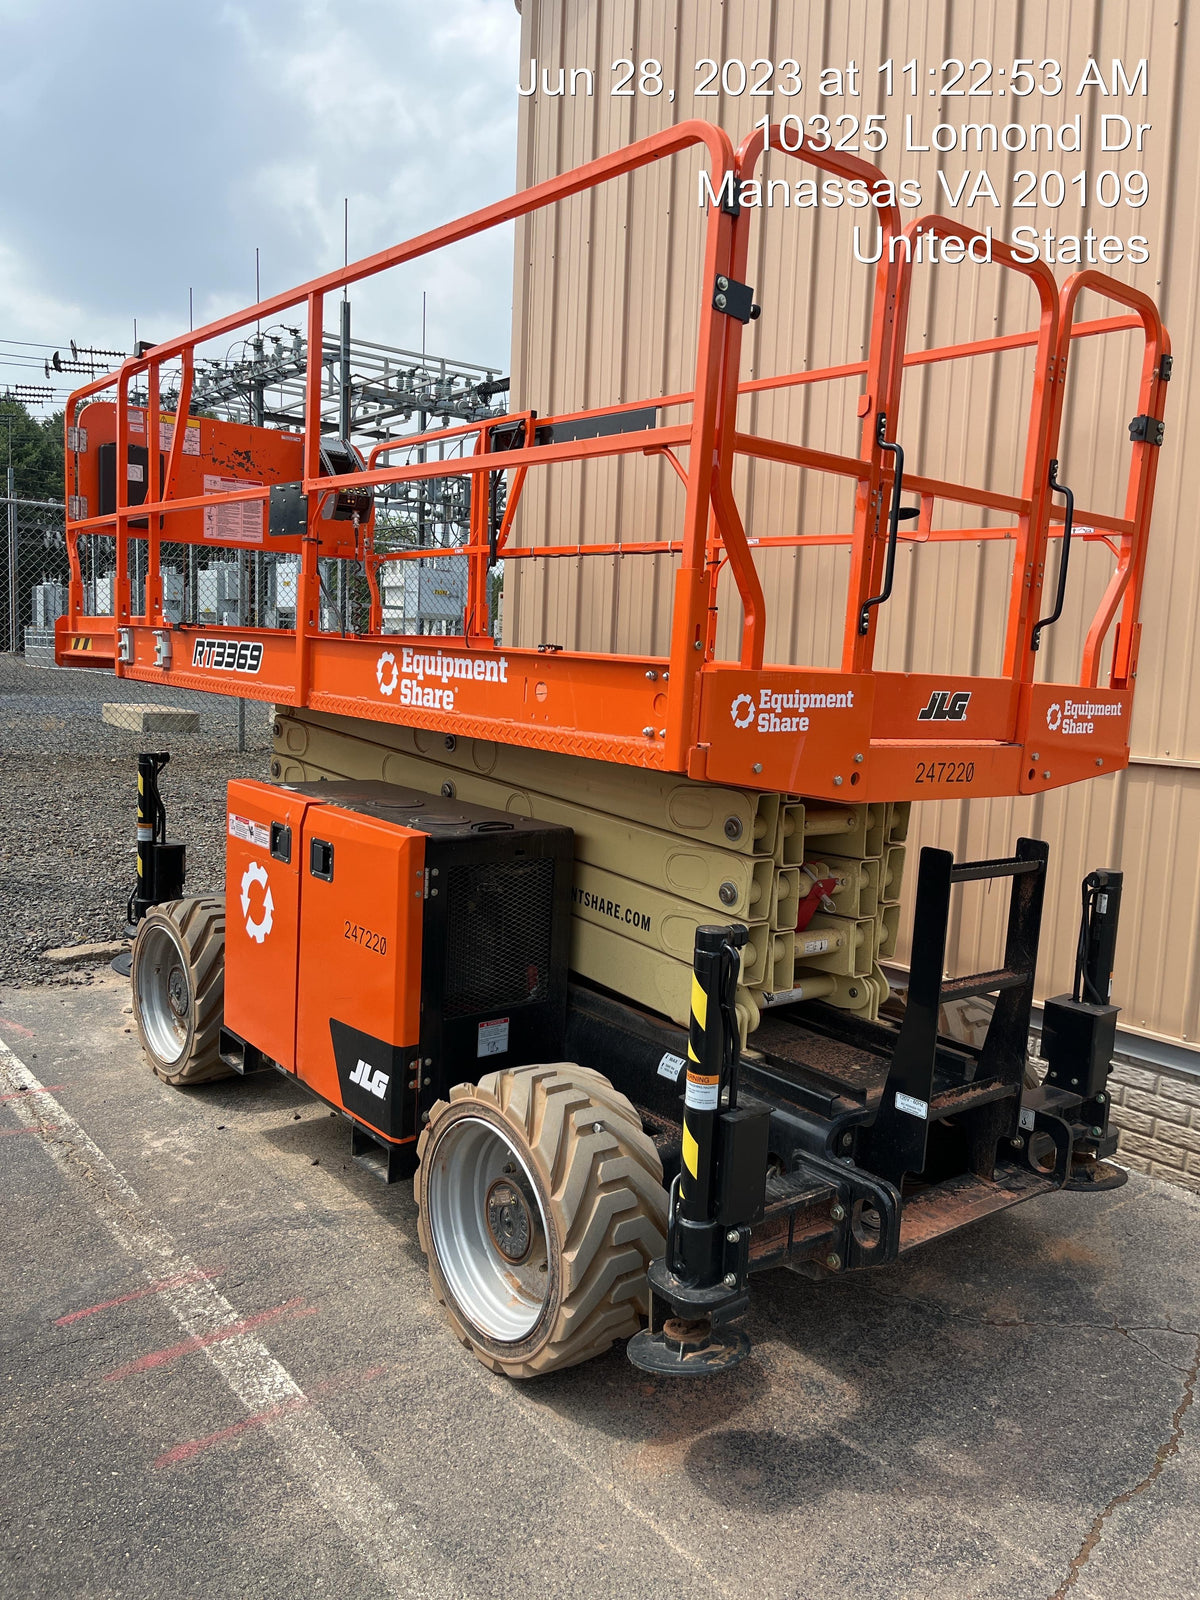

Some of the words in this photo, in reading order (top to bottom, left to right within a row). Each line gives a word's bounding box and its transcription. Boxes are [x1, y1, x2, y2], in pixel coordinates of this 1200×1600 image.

[192, 639, 263, 672] RT3369
[401, 648, 509, 684] Equipment
[400, 679, 454, 710] Share
[759, 689, 854, 711] Equipment
[917, 691, 971, 721] JLG
[1063, 700, 1122, 717] Equipment
[757, 713, 809, 733] Share
[1062, 718, 1094, 734] Share
[915, 762, 975, 784] 247220
[344, 920, 387, 956] 247220
[349, 1059, 390, 1100] JLG
